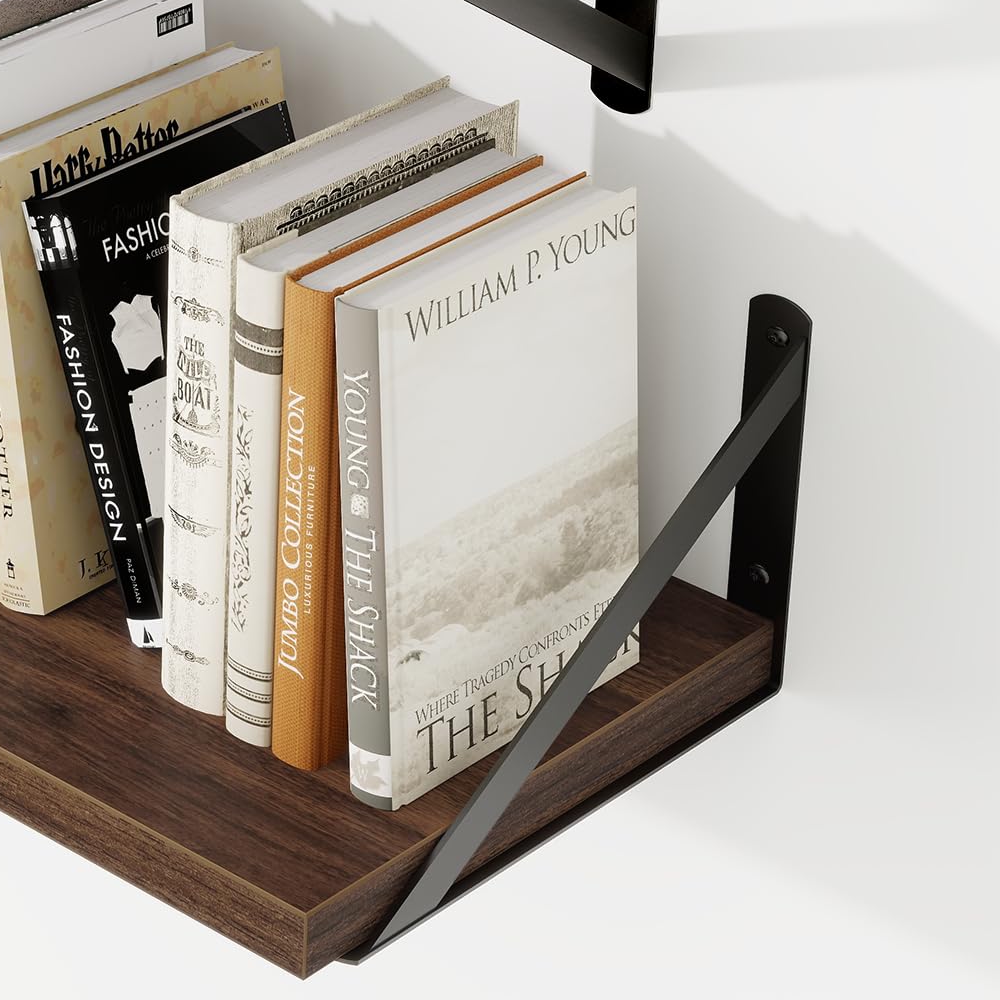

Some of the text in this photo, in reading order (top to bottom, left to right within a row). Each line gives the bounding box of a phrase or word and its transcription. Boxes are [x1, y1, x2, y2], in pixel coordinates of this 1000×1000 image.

[101, 211, 171, 262] FASHIO
[404, 205, 636, 342] WILLIAM P. YOUNG
[177, 378, 213, 411] BOAT
[184, 335, 205, 357] THE
[56, 313, 99, 432] FASHION
[89, 443, 127, 542] DESIGN
[125, 557, 136, 573] PAZ
[278, 387, 306, 680] JUMBO COLLECTION
[304, 465, 316, 615] LUXURIOUS FURNITURE
[343, 370, 380, 712] YOUNG THE SHACK
[415, 611, 590, 725] WHERE TRAGEDY CONFRONTS
[416, 691, 499, 774] THE
